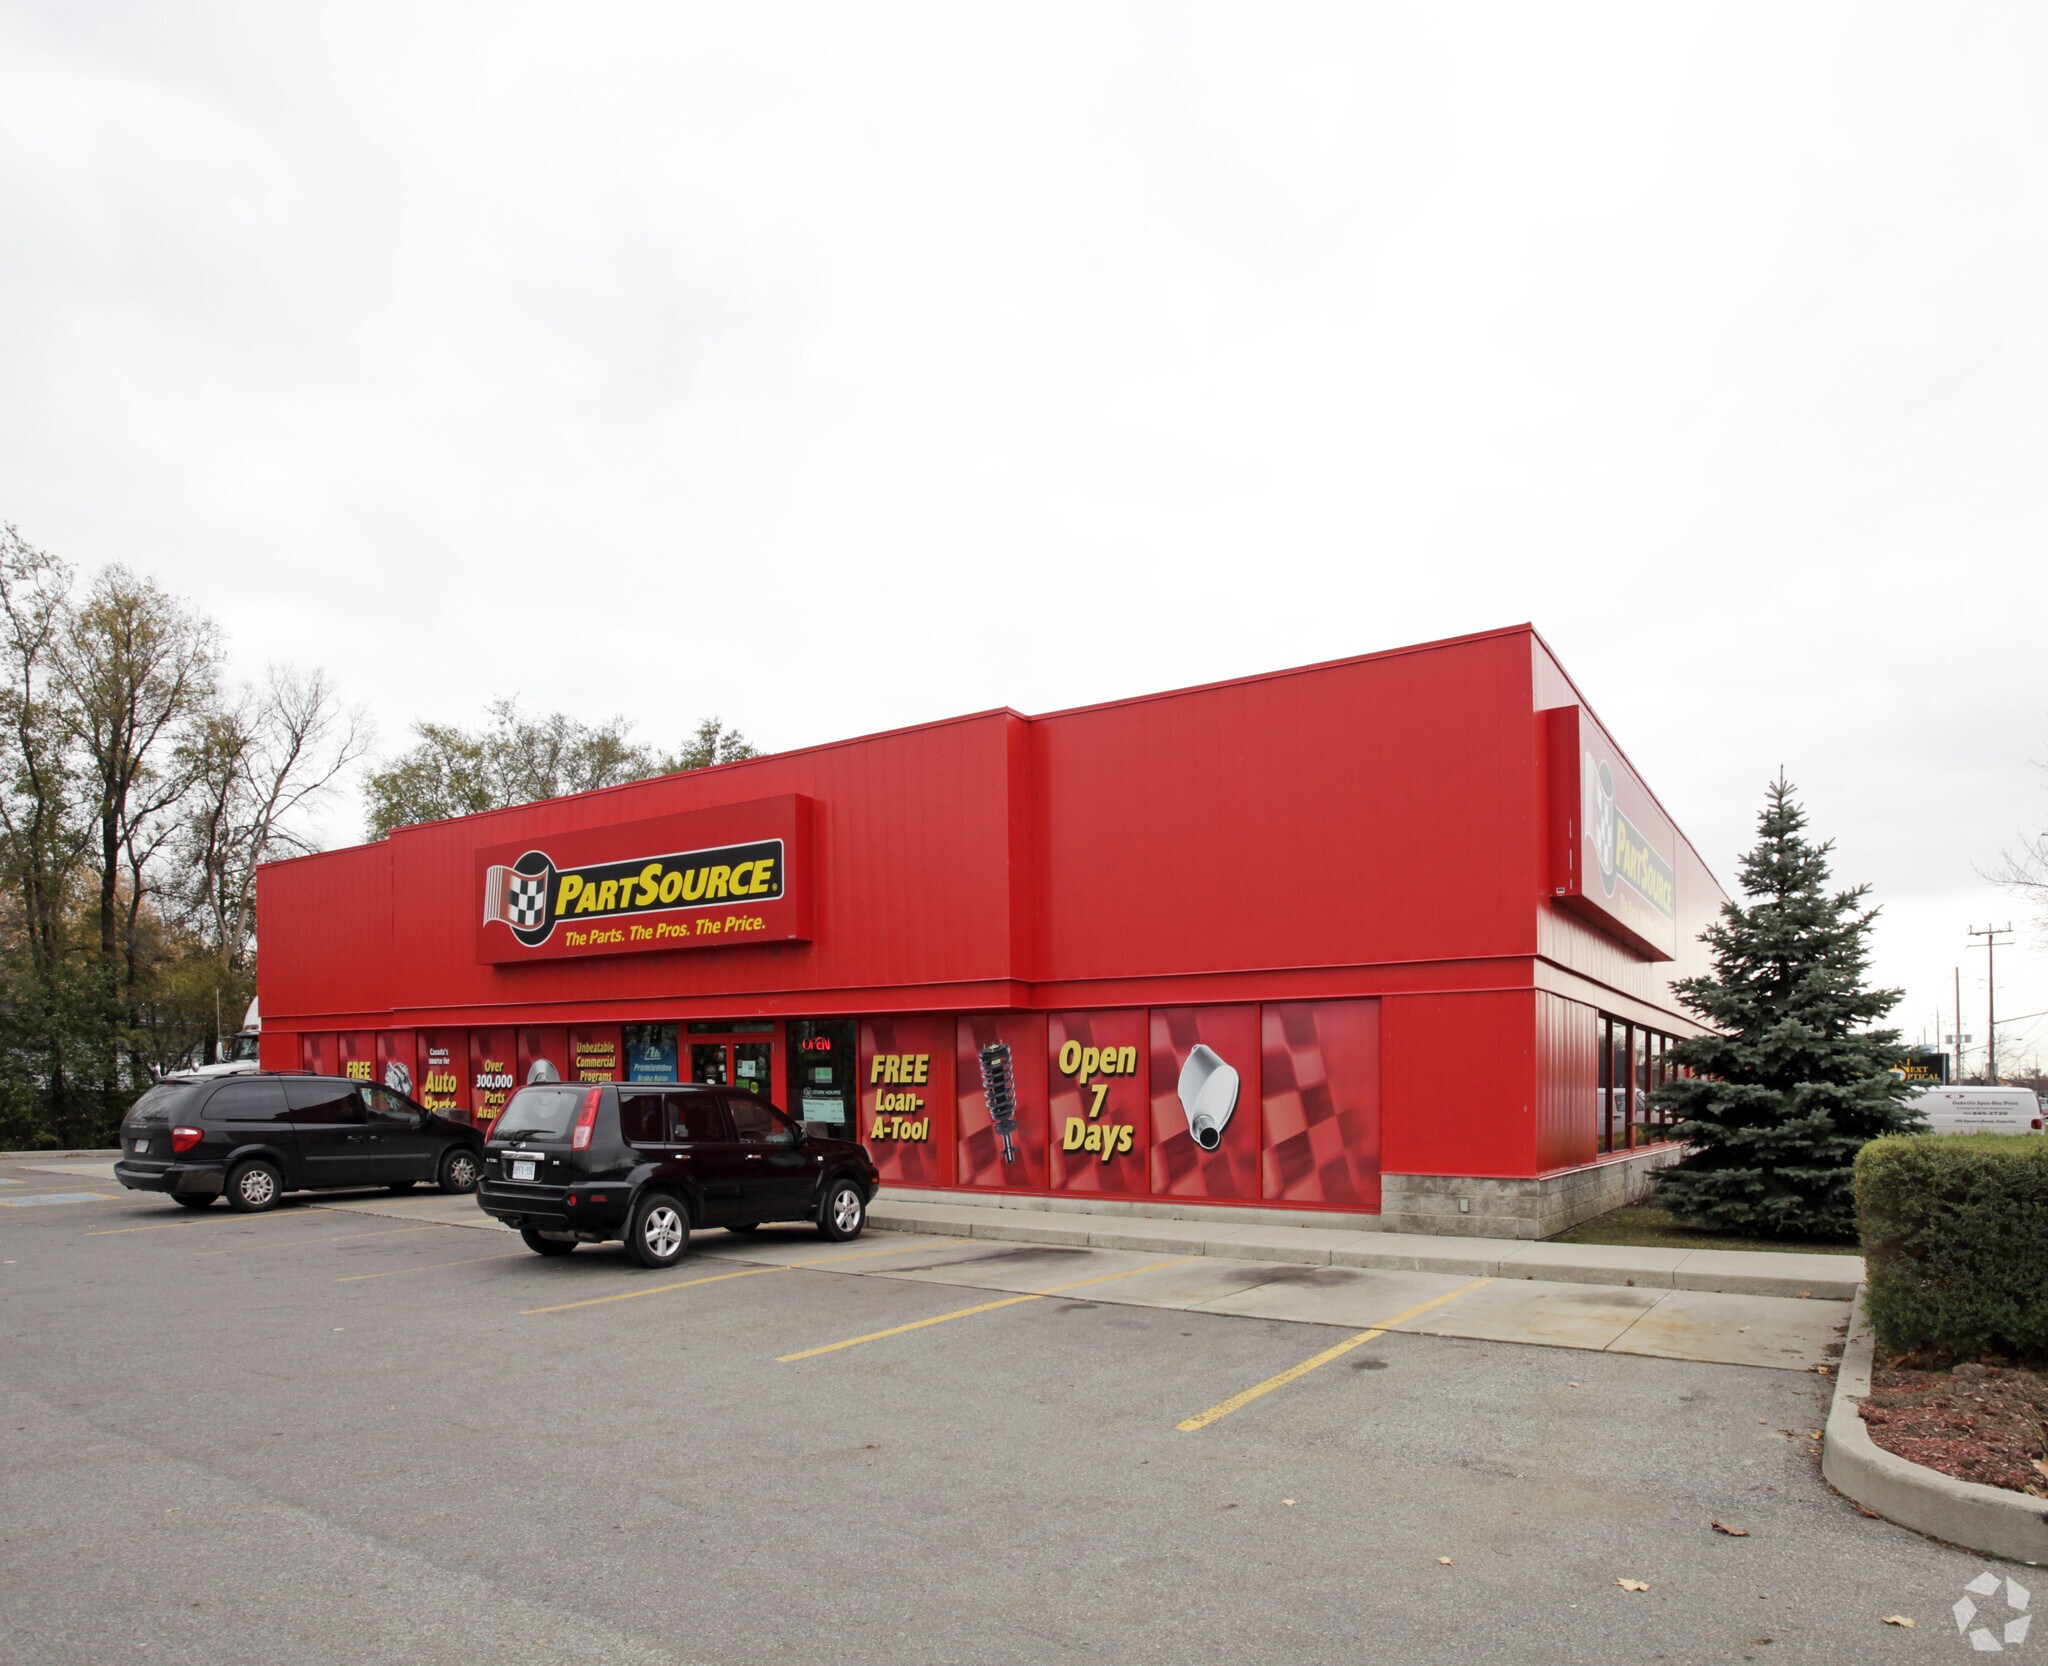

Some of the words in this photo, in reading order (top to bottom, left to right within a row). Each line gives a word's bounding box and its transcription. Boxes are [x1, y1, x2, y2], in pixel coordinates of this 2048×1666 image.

[554, 859, 775, 916] PARTSOURCE
[565, 932, 587, 947] The
[589, 929, 625, 944] Parts.
[630, 925, 653, 941] The
[656, 923, 690, 939] Pros.
[695, 919, 721, 935] The
[724, 915, 766, 933] Price.
[429, 1048, 449, 1056] Canada's
[576, 1042, 615, 1053] Unbeatable
[801, 1037, 831, 1050] OPEN
[346, 1061, 371, 1079] FREE
[484, 1060, 504, 1072] Over
[576, 1056, 616, 1068] Commercial
[870, 1054, 929, 1083] FREE
[1059, 1040, 1137, 1084] Open
[424, 1071, 457, 1093] Auto
[476, 1074, 513, 1090] 300,000
[580, 1071, 612, 1083] Programs
[484, 1091, 505, 1104] Parts
[875, 1088, 924, 1112] Loan-
[1089, 1084, 1108, 1118] 7
[870, 1116, 929, 1140] A-Tool
[1063, 1117, 1134, 1161] Days
